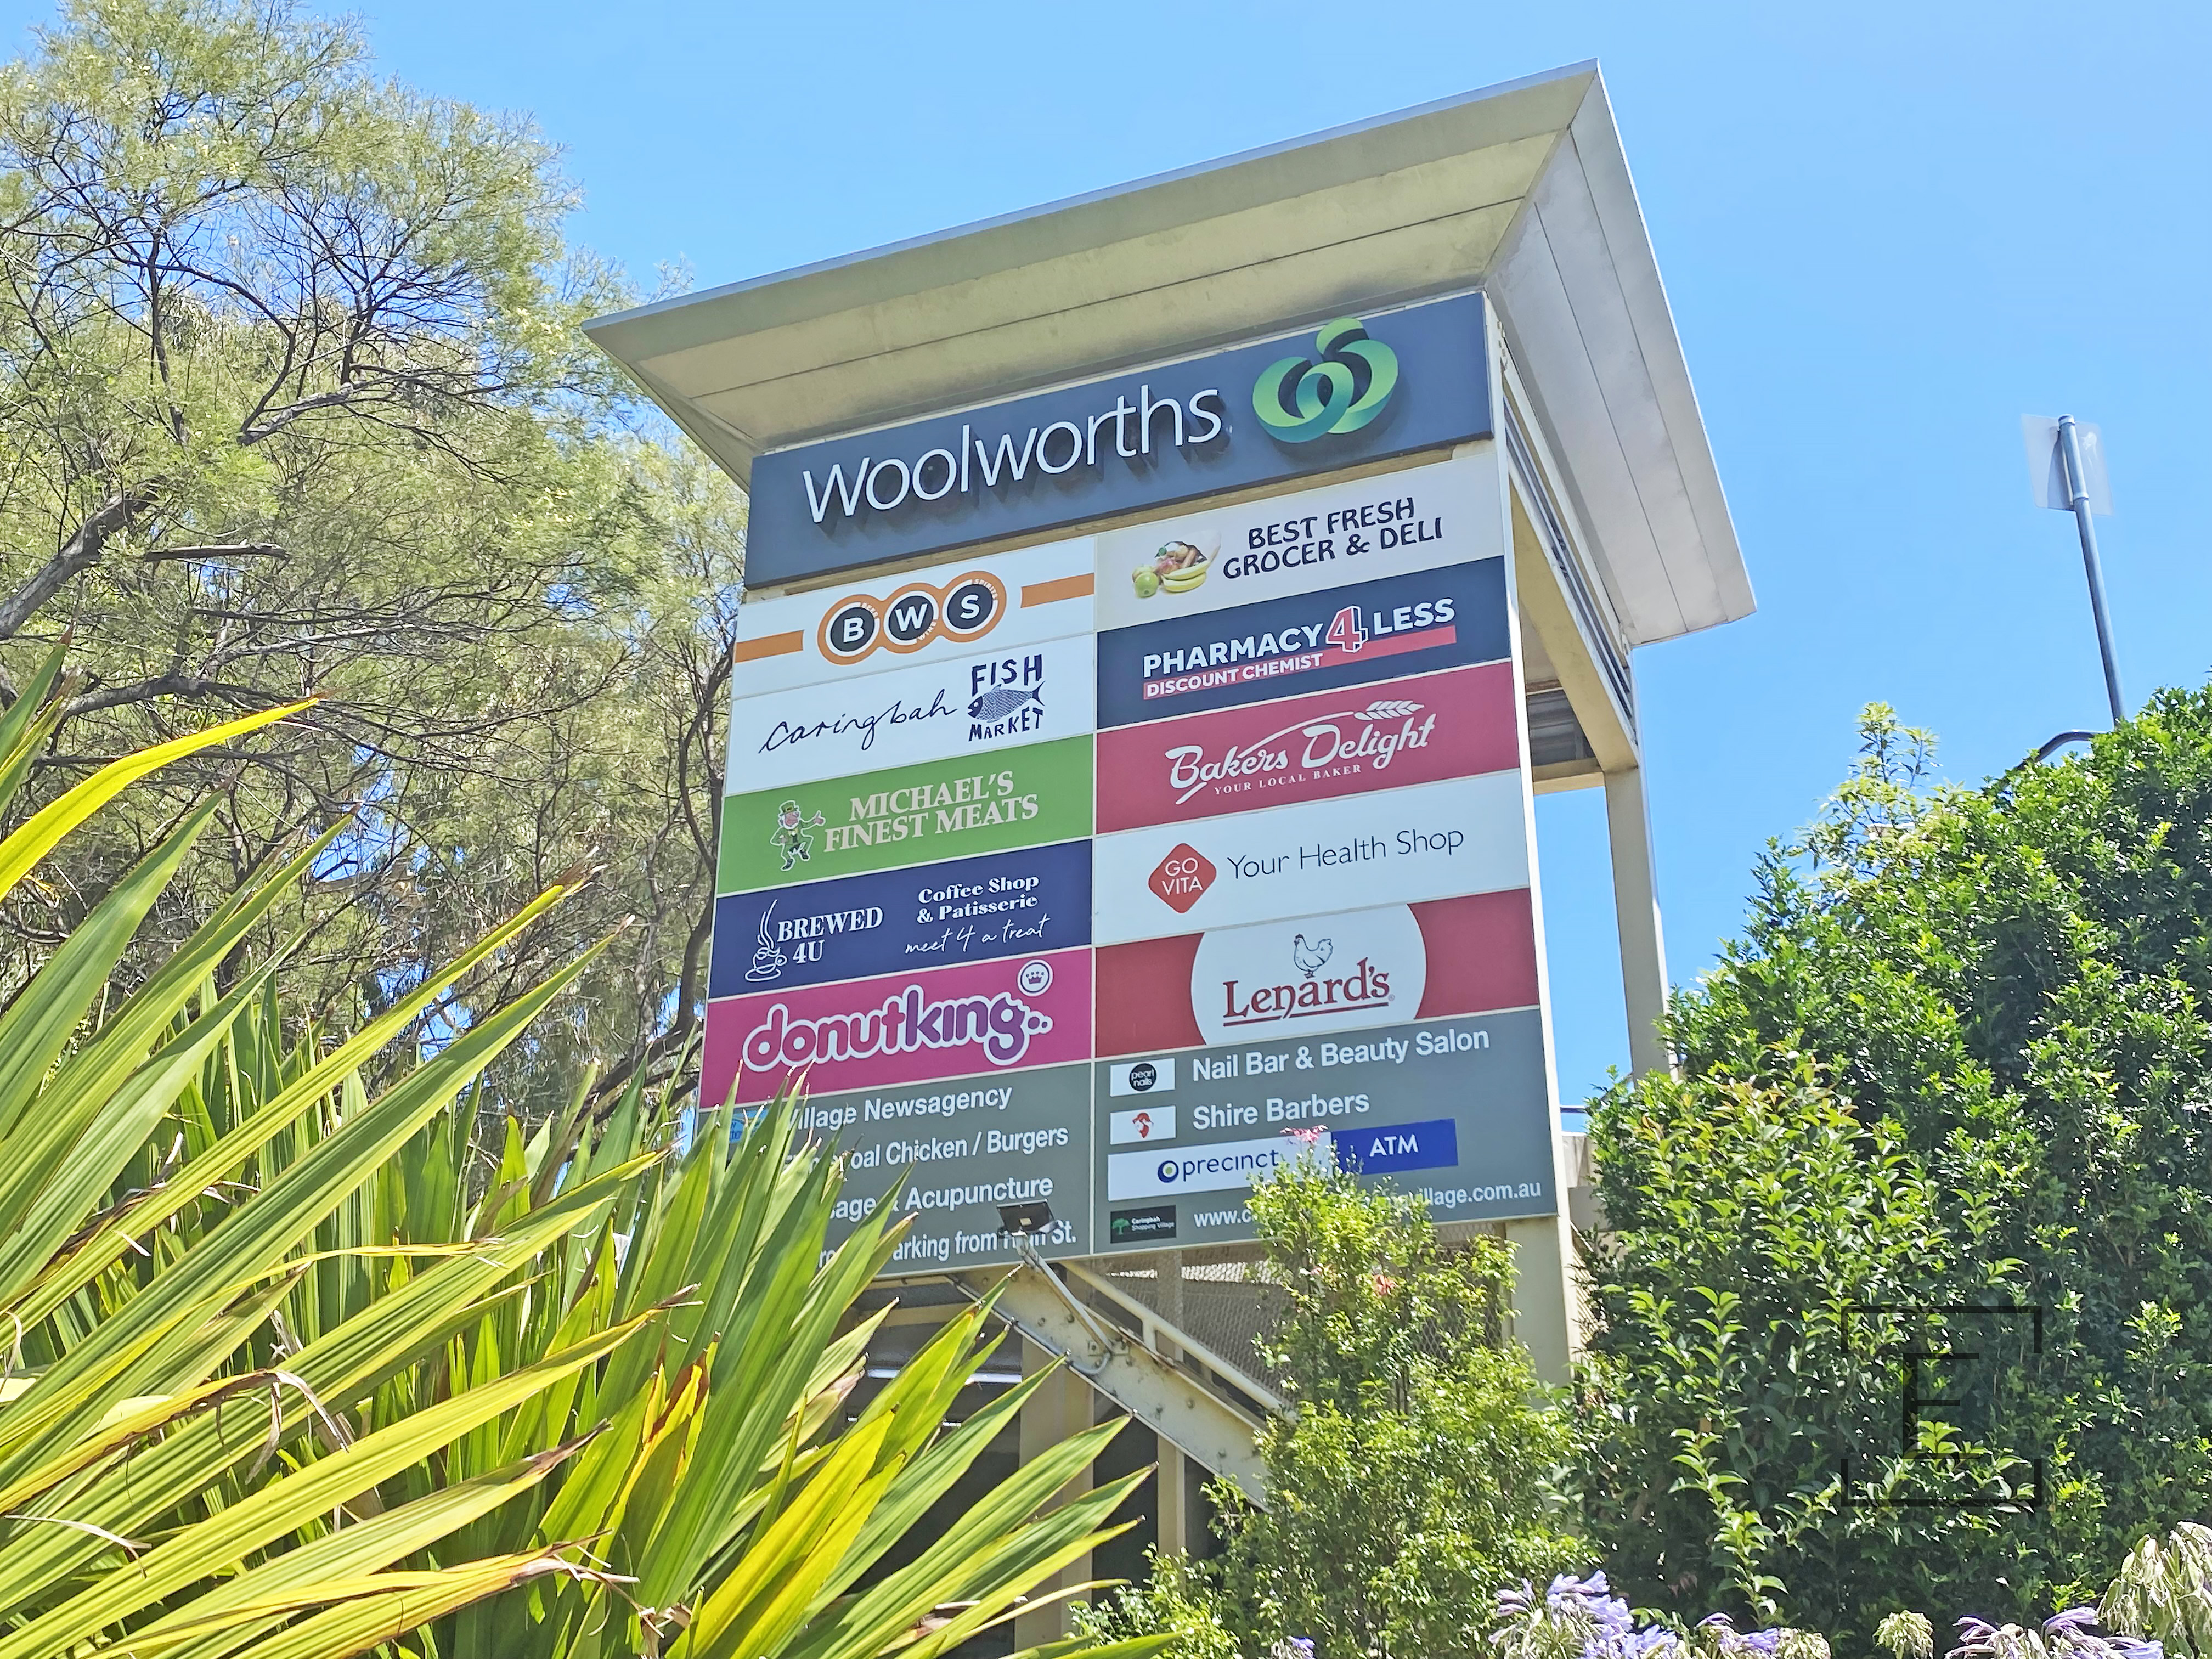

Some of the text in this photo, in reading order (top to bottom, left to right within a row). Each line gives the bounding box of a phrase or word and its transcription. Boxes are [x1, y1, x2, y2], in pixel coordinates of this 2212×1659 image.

[803, 385, 1222, 523] Woolworths
[1248, 497, 1414, 550] BEST FRESH
[1223, 517, 1443, 579] GROCER & DELI
[1144, 597, 1455, 678] PHARMACY 4 LESS
[972, 654, 1042, 697] FISH
[1147, 653, 1323, 697] DISCOUNT CHEMIST
[759, 689, 958, 753] Caringbah
[968, 706, 1043, 742] MARKET
[1165, 713, 1437, 795] Bakers Delight
[849, 771, 1014, 822] MICHAEL'S
[1214, 765, 1362, 795] YOUR LOCAL BAKER
[824, 794, 1039, 853] FINEST MEATS
[1164, 857, 1199, 877] GO
[1227, 828, 1464, 880] Your Health Shop
[918, 876, 1039, 904] Coffee Shop
[1162, 876, 1203, 895] VITA
[777, 907, 884, 943] BREWED
[917, 894, 1038, 924] & Patisserie
[793, 939, 825, 964] 4U
[905, 913, 1051, 955] meet 4 a treat
[1222, 957, 1390, 1019] Lenard's
[1192, 1028, 1490, 1082] Nail Bar & Beauty Salon
[1131, 1068, 1154, 1080] pearl
[1133, 1078, 1152, 1087] nails
[865, 1087, 1013, 1124] Newsagency
[1192, 1093, 1370, 1131] Shire Barbers
[886, 1138, 968, 1165] Chicken
[972, 1132, 982, 1155] /
[987, 1126, 1068, 1155] Burgers
[1369, 1133, 1419, 1158] ATM
[1183, 1149, 1280, 1182] precinct
[905, 1175, 1054, 1211] Acupuncture
[893, 1234, 949, 1261] arking
[955, 1231, 997, 1254] from
[1051, 1220, 1076, 1244] St.
